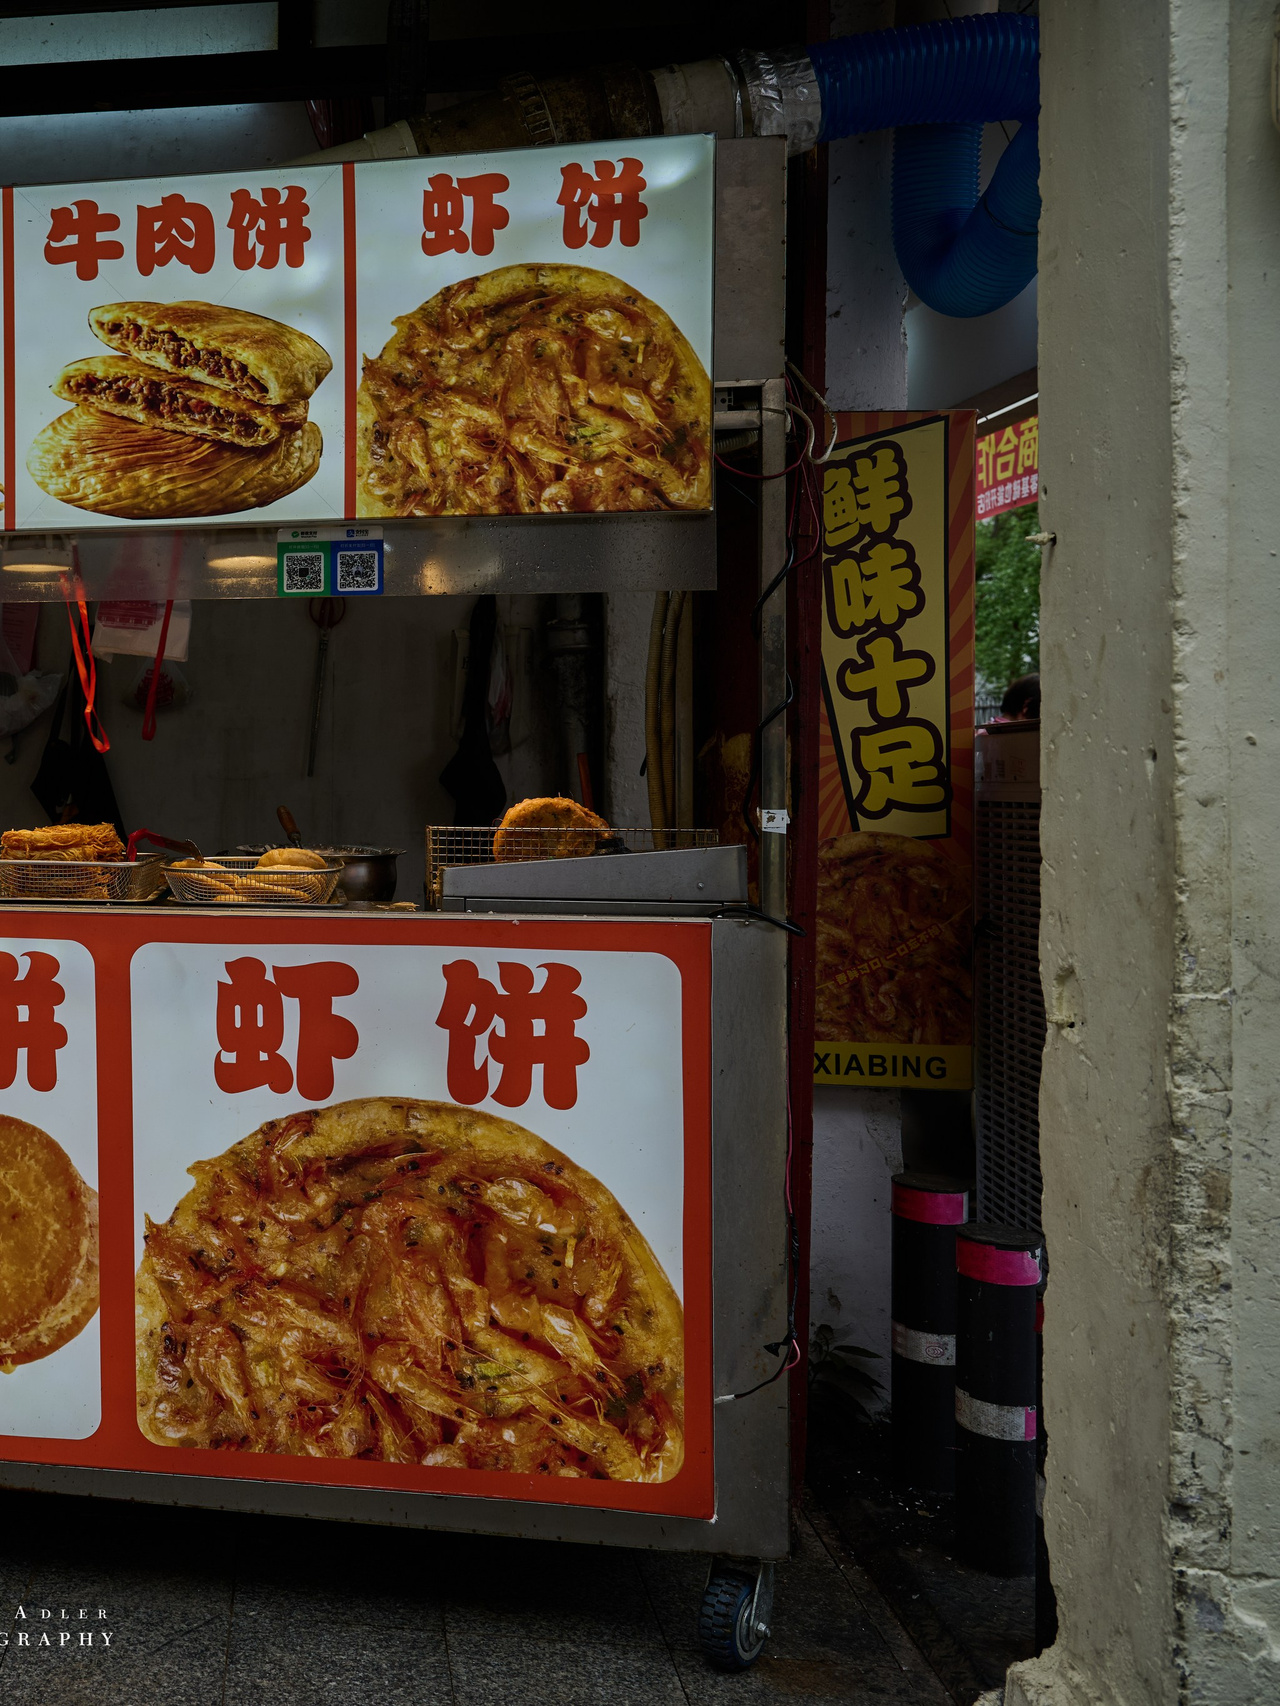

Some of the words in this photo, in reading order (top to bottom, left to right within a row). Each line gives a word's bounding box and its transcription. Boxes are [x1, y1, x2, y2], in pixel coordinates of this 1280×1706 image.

[44, 185, 311, 281] 牛肉饼
[421, 157, 648, 257] 虾饼
[822, 443, 949, 817] 鲜味十足
[214, 956, 590, 1110] 虾饼
[814, 1053, 947, 1080] XIABING
